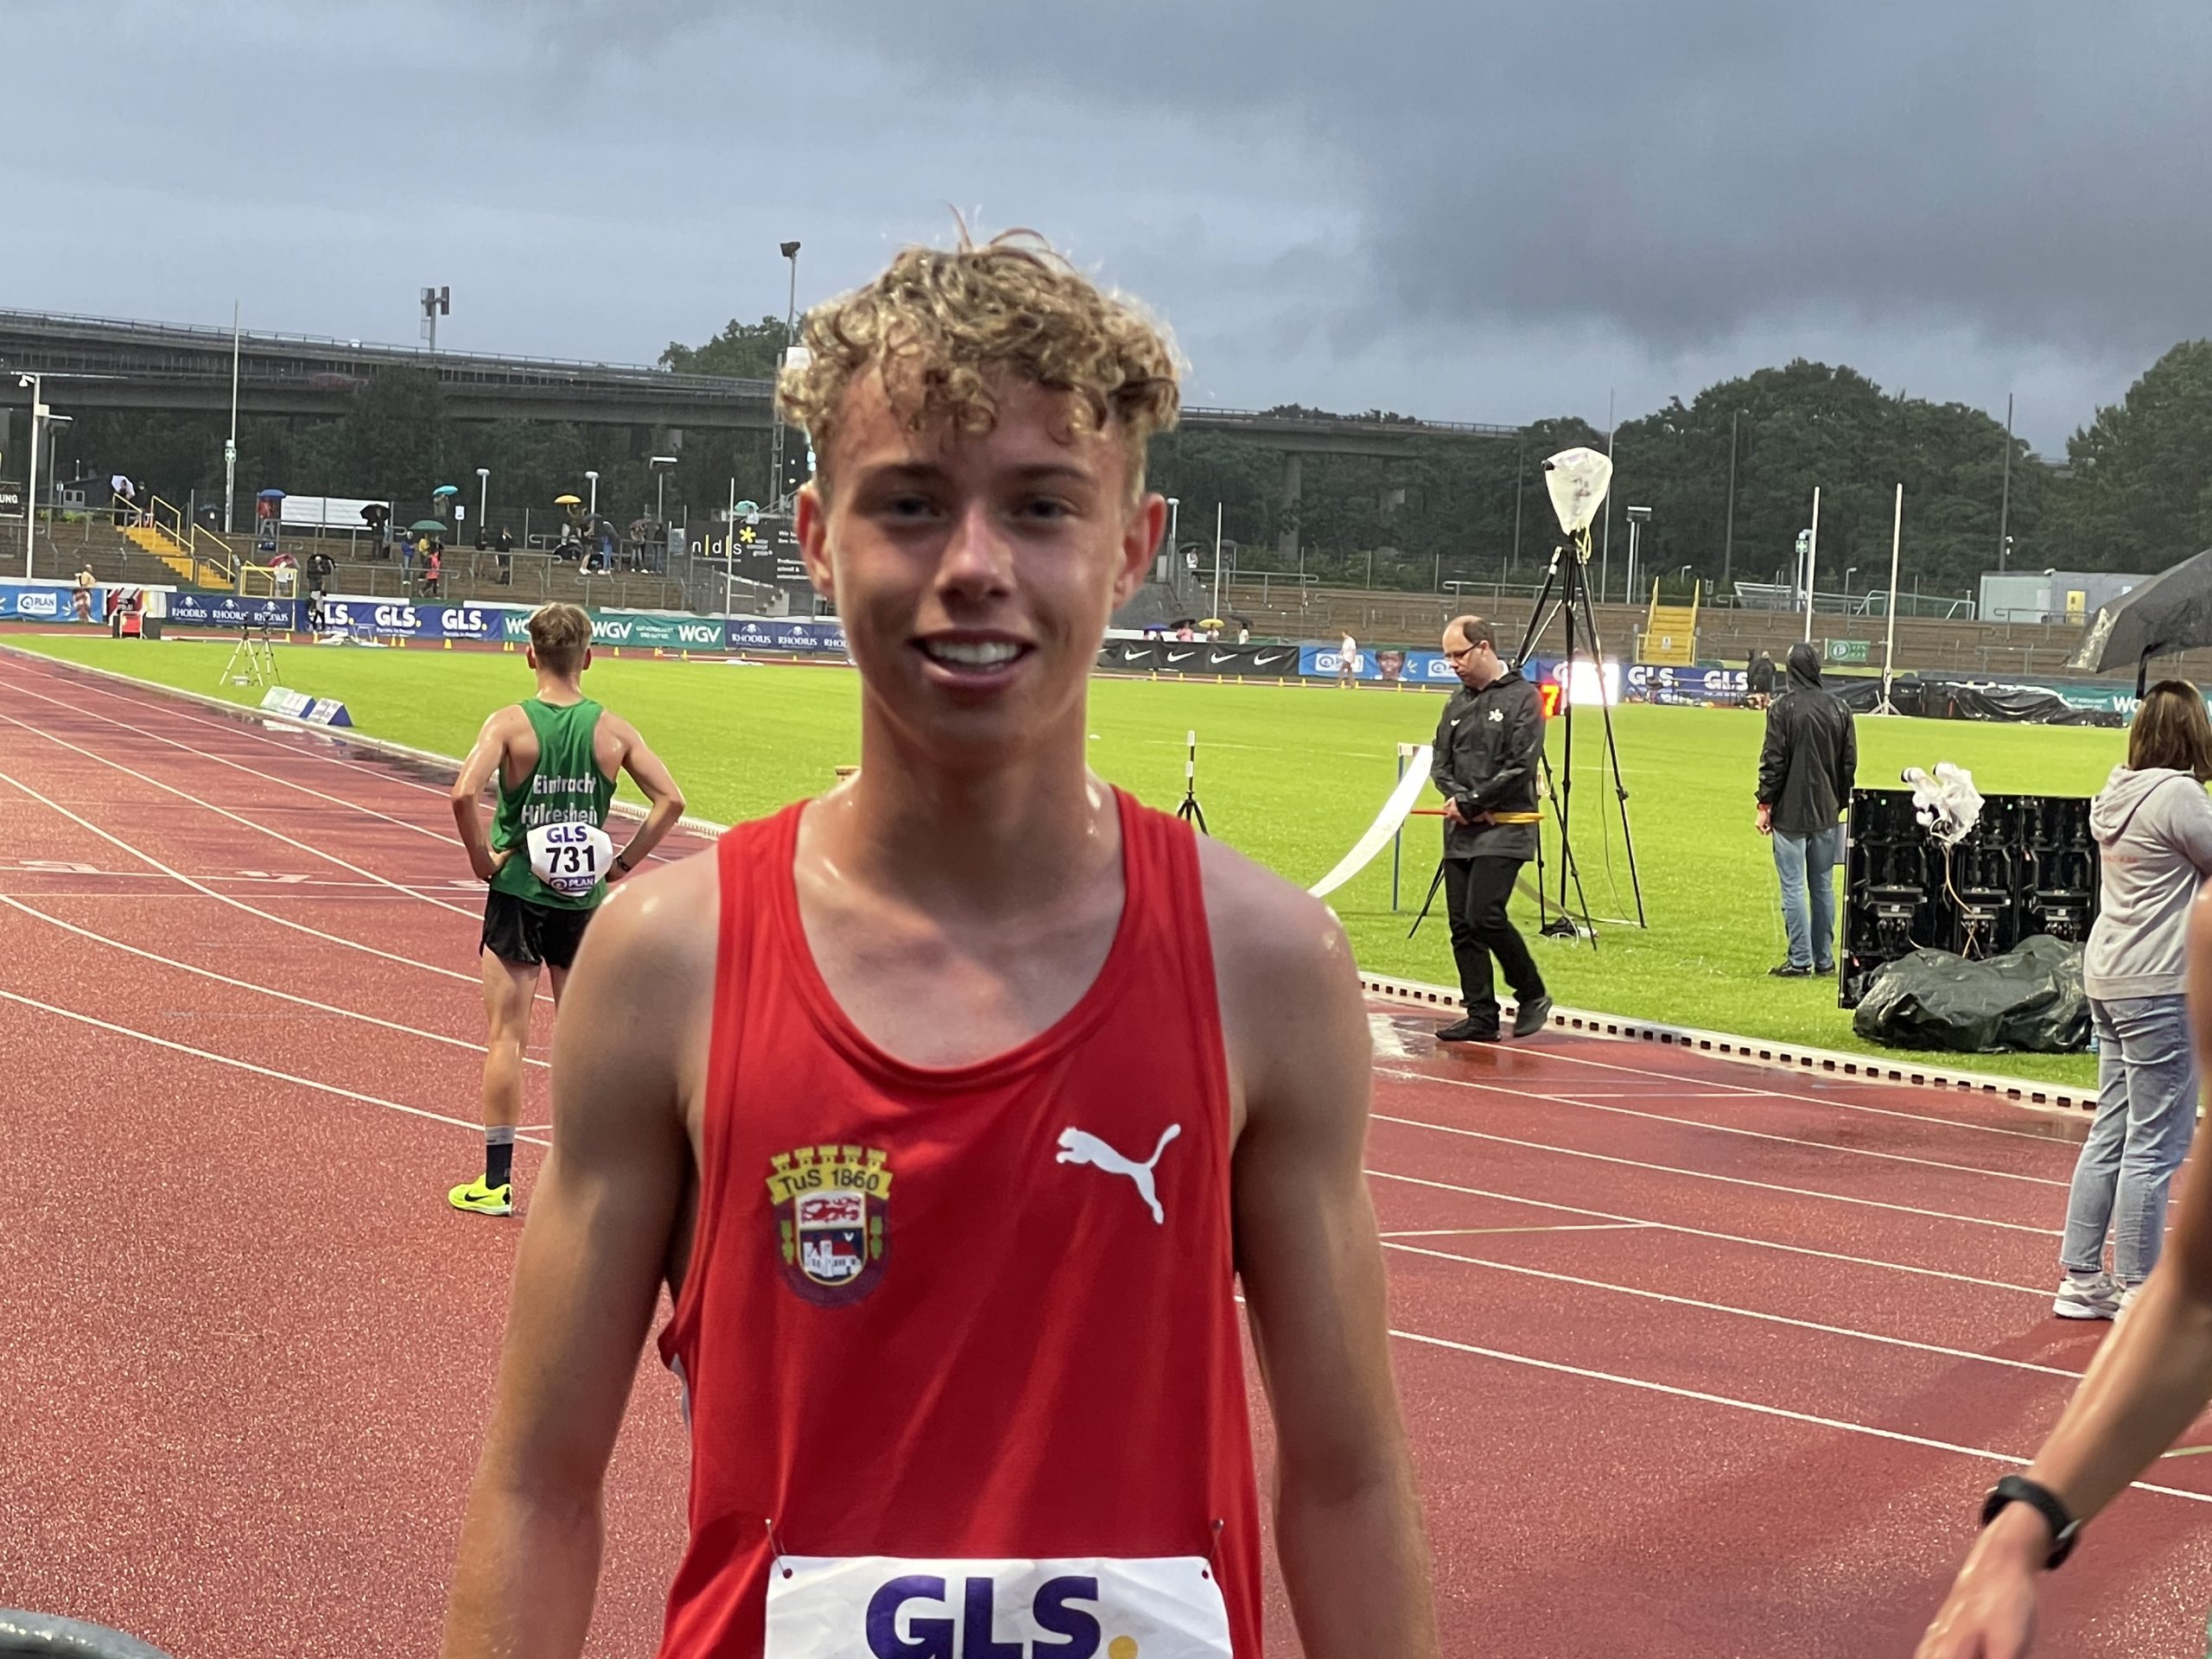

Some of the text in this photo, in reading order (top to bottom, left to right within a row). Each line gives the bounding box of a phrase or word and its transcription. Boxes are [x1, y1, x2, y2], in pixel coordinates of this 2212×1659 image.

[35, 597, 54, 607] PLAN
[172, 607, 207, 618] RHODIUS
[254, 612, 289, 621] RHDIUS
[592, 621, 632, 639] WGV
[678, 625, 721, 643] WGV
[732, 633, 772, 644] RHODIUS
[779, 636, 817, 646] RHODIUS
[533, 772, 597, 794] Eintracht
[545, 845, 595, 874] 731
[569, 878, 594, 887] PLAN
[779, 1168, 880, 1194] TuS 1860
